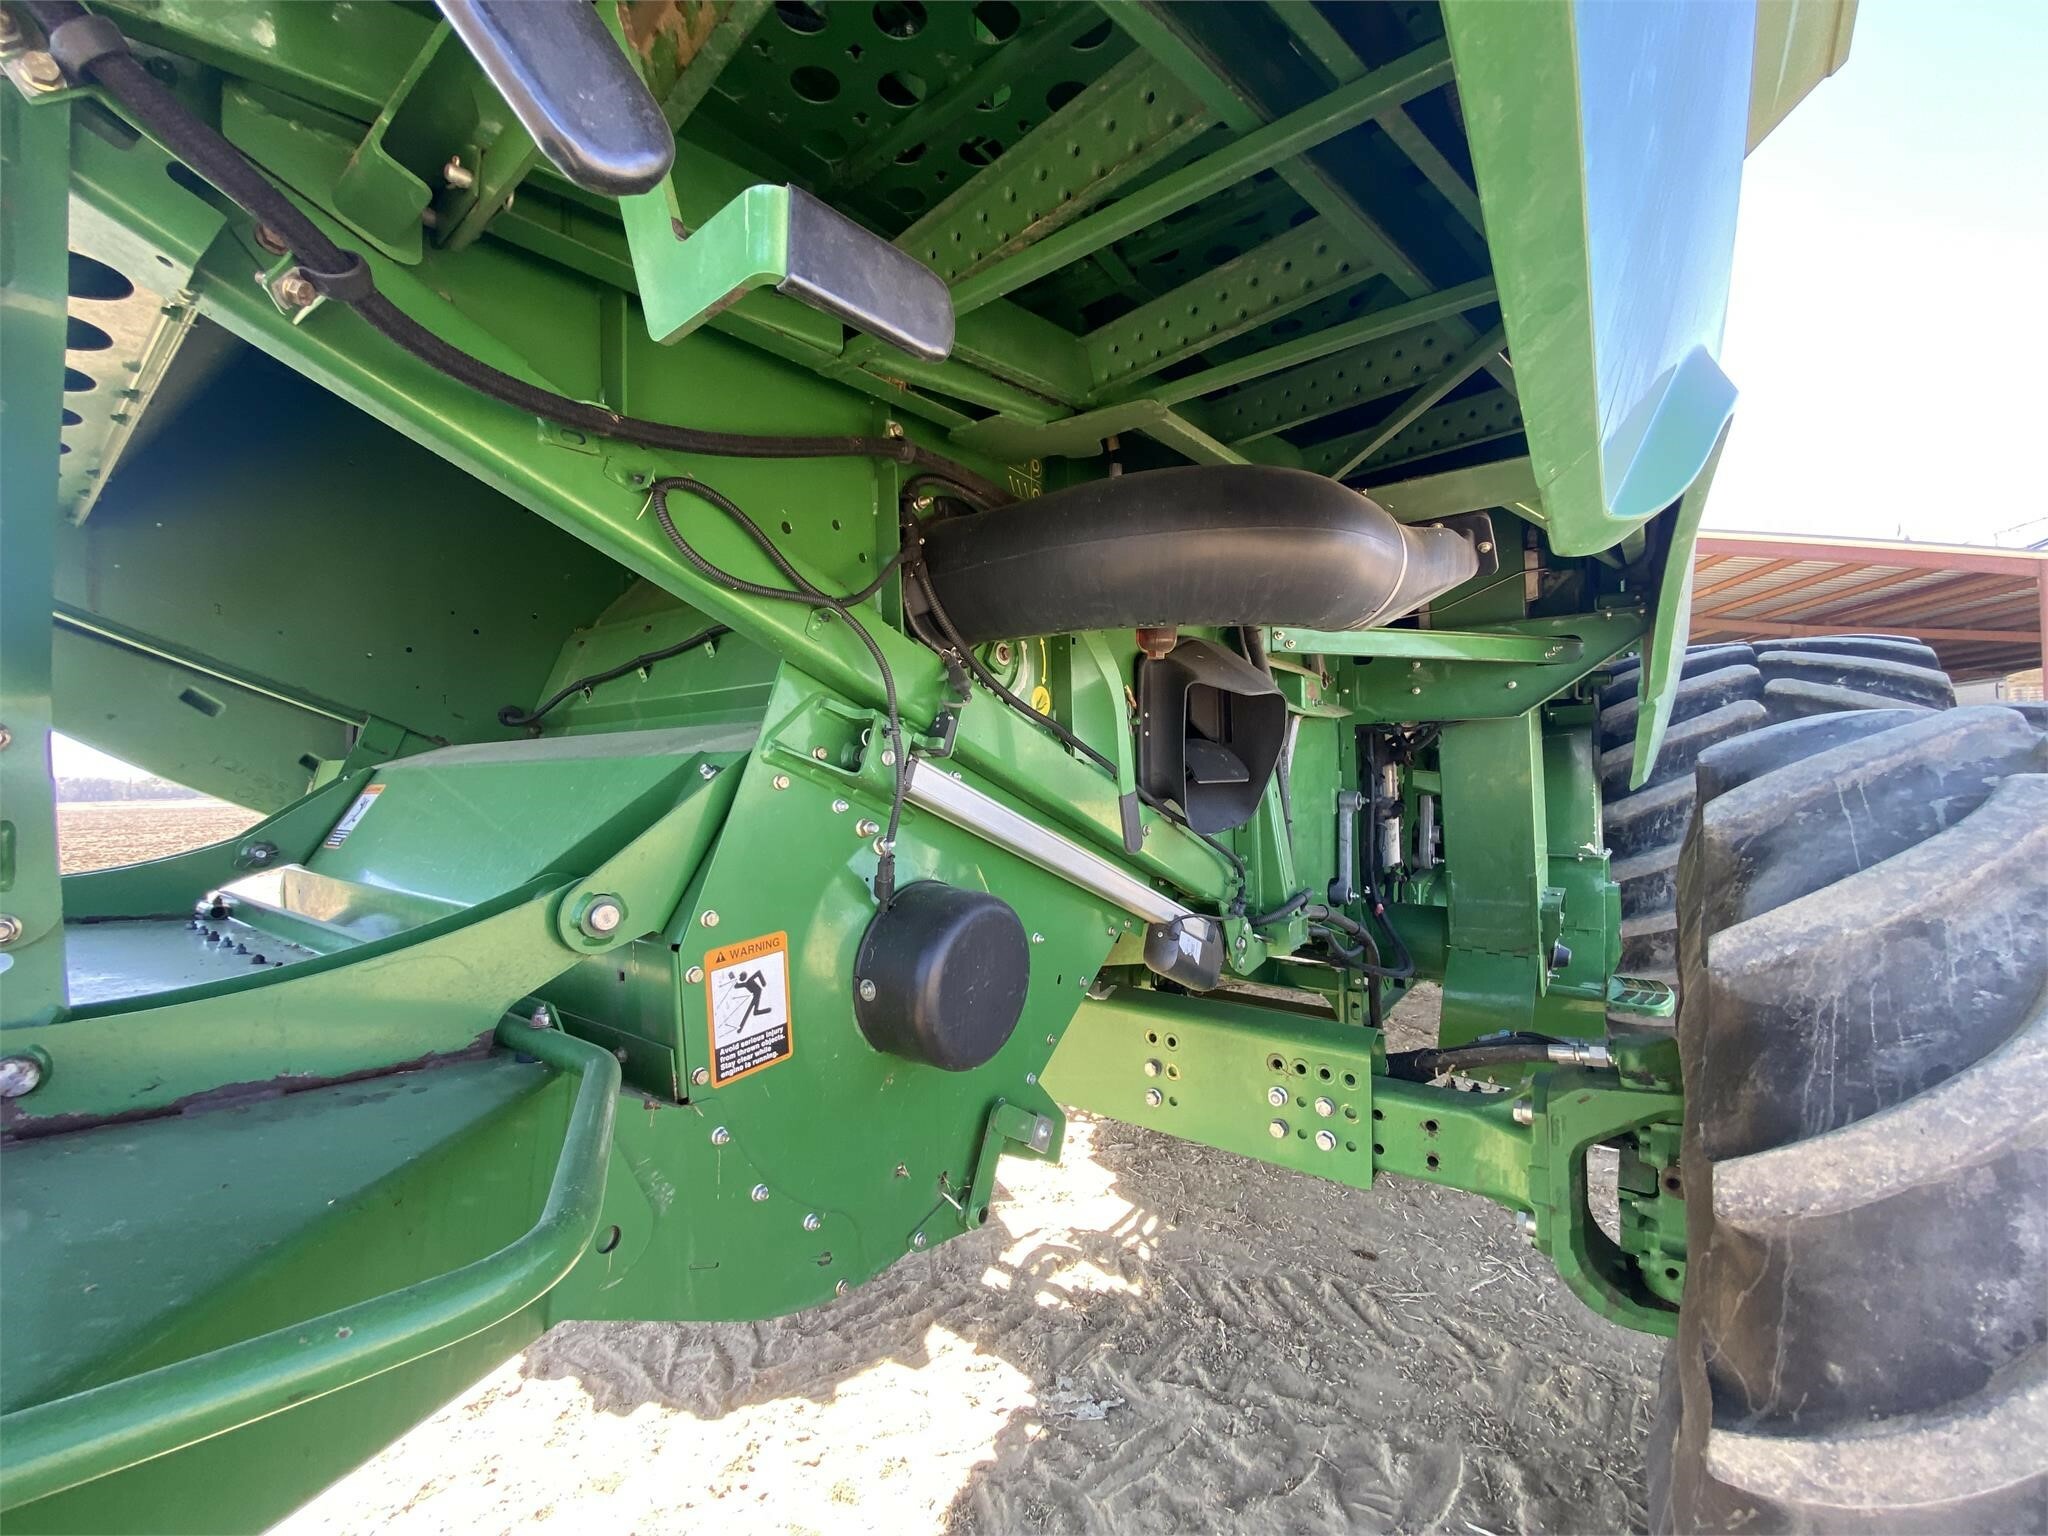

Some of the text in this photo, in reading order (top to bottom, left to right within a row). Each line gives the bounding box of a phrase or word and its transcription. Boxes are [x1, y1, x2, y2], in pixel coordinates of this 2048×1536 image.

[729, 938, 780, 959] WARNING
[720, 1027, 783, 1055] Avoid serious injury
[720, 1034, 785, 1063] from thrown objects.
[720, 1046, 772, 1071] Stay clear while
[720, 1051, 778, 1079] engine is running.
